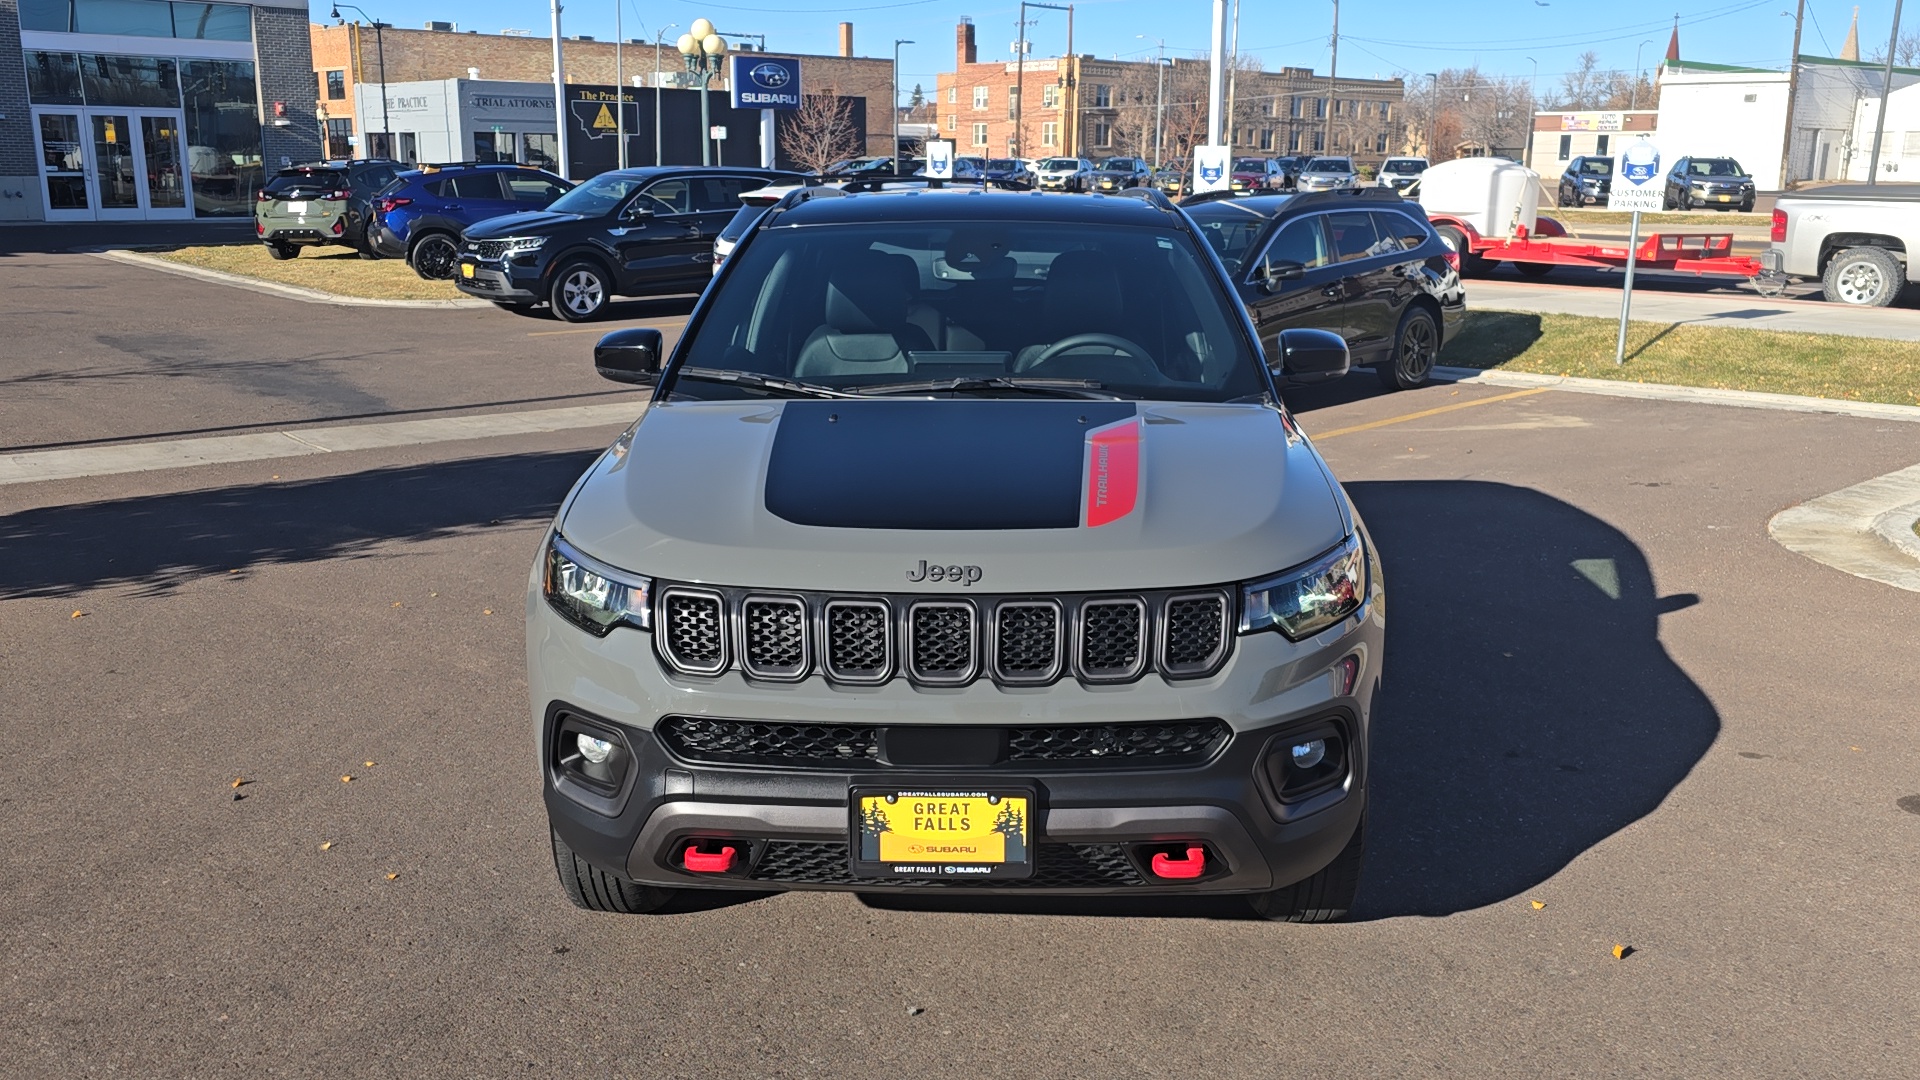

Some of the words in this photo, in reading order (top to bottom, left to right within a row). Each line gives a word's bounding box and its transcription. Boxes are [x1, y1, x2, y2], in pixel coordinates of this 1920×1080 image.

[579, 90, 597, 100] The
[741, 92, 797, 104] SUBARU
[397, 96, 428, 108] PRACTICE
[475, 97, 505, 107] TRIAL
[1610, 189, 1665, 198] CUSTOMER
[1613, 199, 1657, 208] PARKING
[1096, 444, 1109, 508] TRAILHAWK
[905, 559, 983, 587] Jeep
[913, 802, 971, 815] GREAT
[914, 817, 971, 831] FALLS
[956, 866, 991, 874] SUBARU
